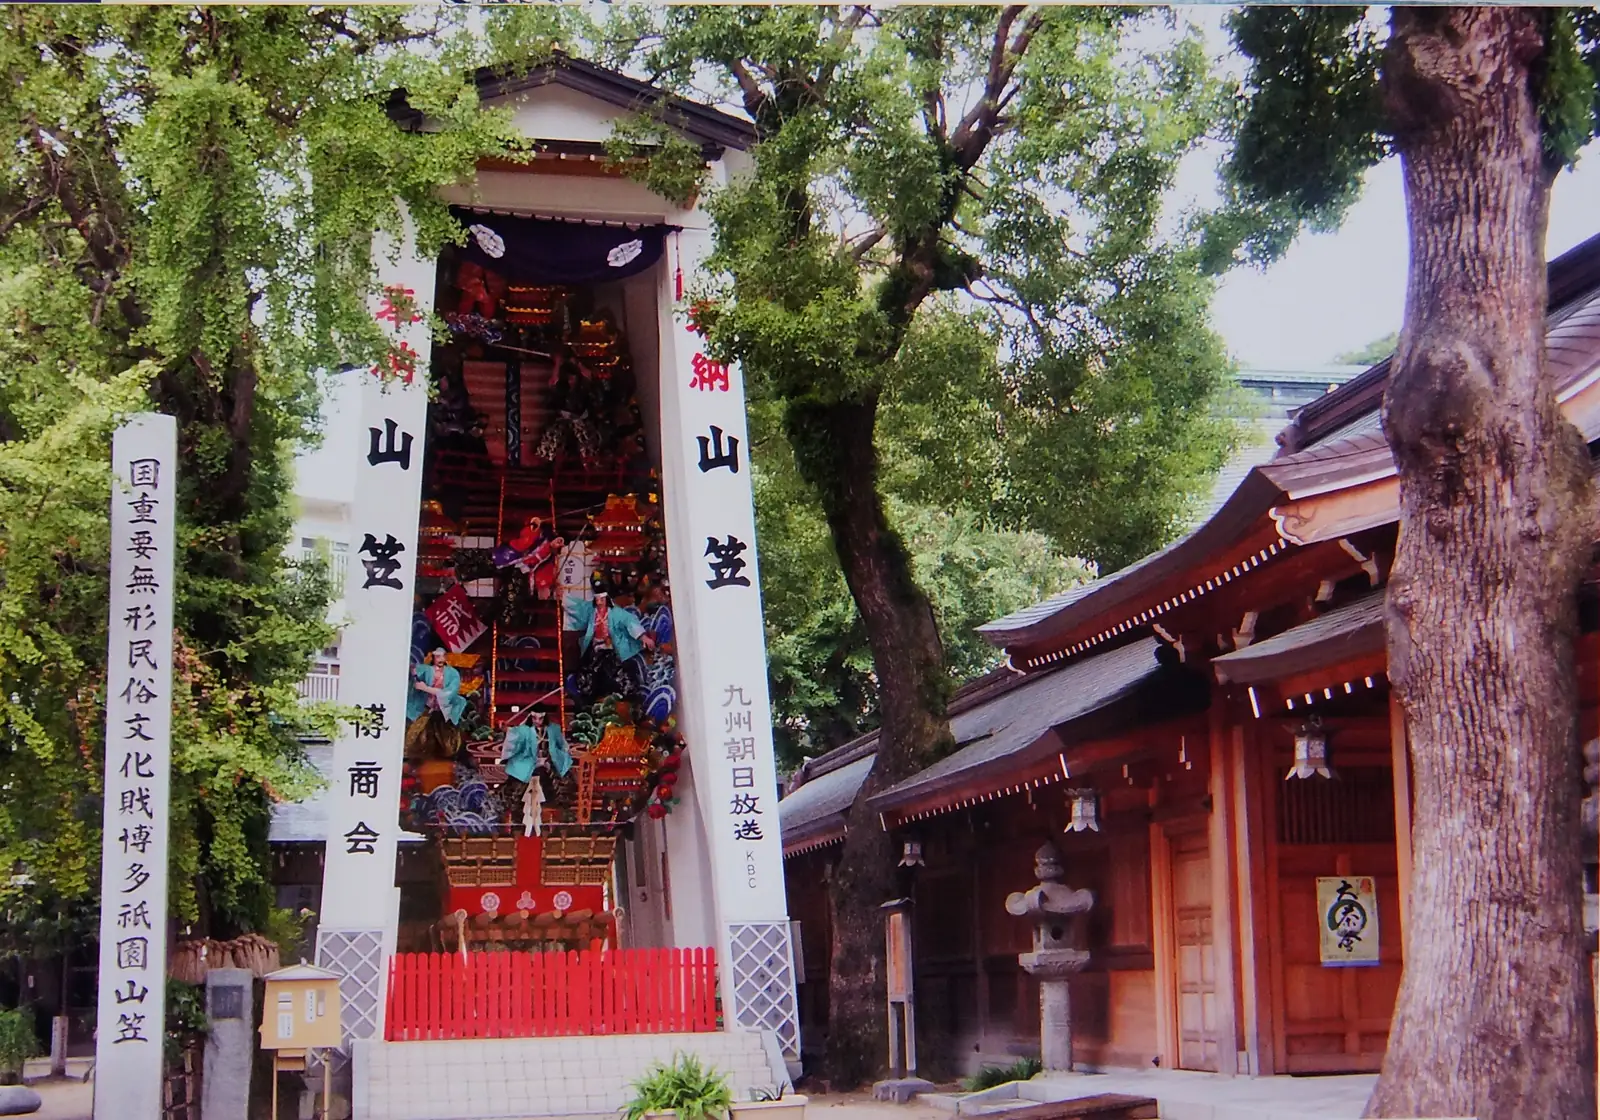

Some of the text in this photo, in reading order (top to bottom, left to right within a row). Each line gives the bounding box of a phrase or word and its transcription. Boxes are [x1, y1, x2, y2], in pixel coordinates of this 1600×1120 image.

[722, 684, 763, 841] 九州朝日放送
[746, 850, 756, 888] KBC
